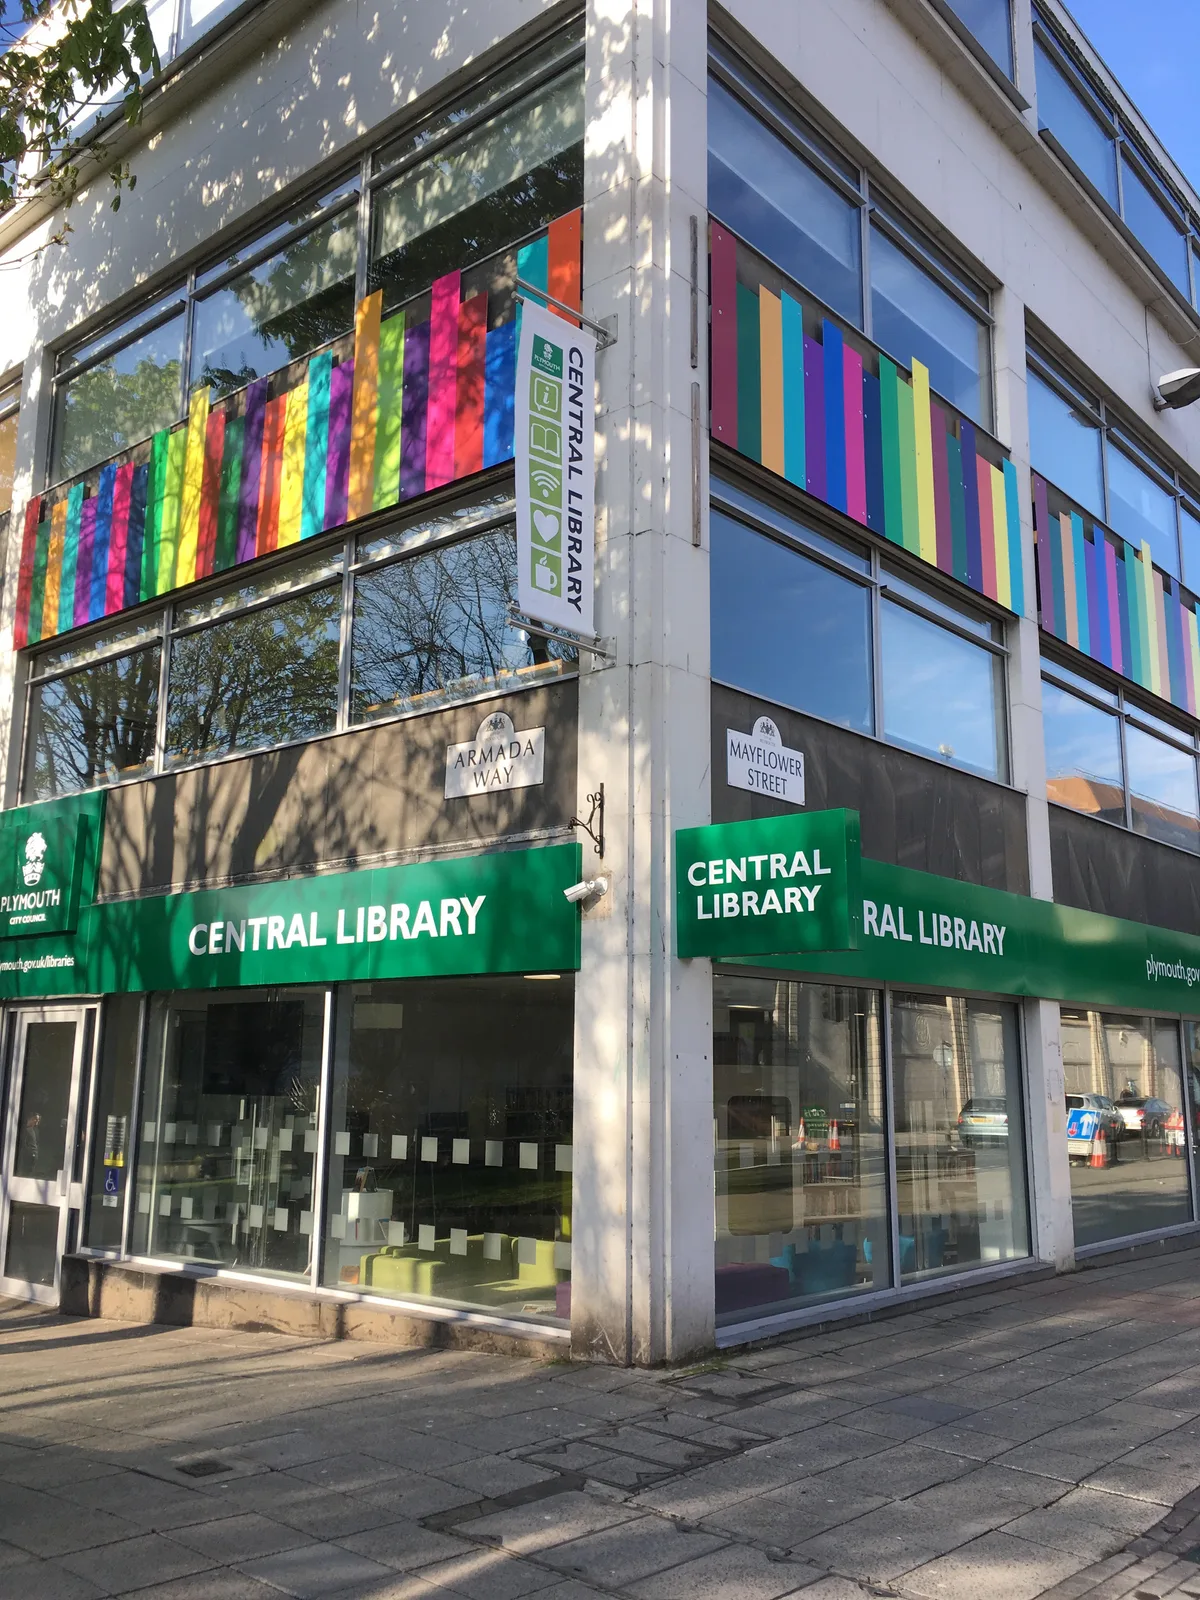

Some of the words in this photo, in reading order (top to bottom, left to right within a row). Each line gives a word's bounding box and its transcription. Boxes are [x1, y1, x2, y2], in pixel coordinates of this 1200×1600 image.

[569, 346, 583, 481] CENTRAL
[568, 490, 583, 614] LIBRARY
[454, 739, 535, 769] ARMADA
[730, 739, 802, 777] MAYFLOWER
[473, 766, 514, 788] WAY
[748, 768, 788, 795] STREET
[687, 849, 831, 886] CENTRAL
[0, 889, 60, 912] PLYMOUTH
[697, 885, 822, 920] LIBRARY
[9, 916, 22, 925] CITY
[22, 913, 46, 924] COUNCIL
[188, 910, 326, 955] CENTRAL
[336, 895, 486, 943] LIBRARY
[863, 899, 912, 942] RAL
[918, 910, 1006, 956] LIBRARY
[1146, 953, 1200, 987] plymouth.gov
